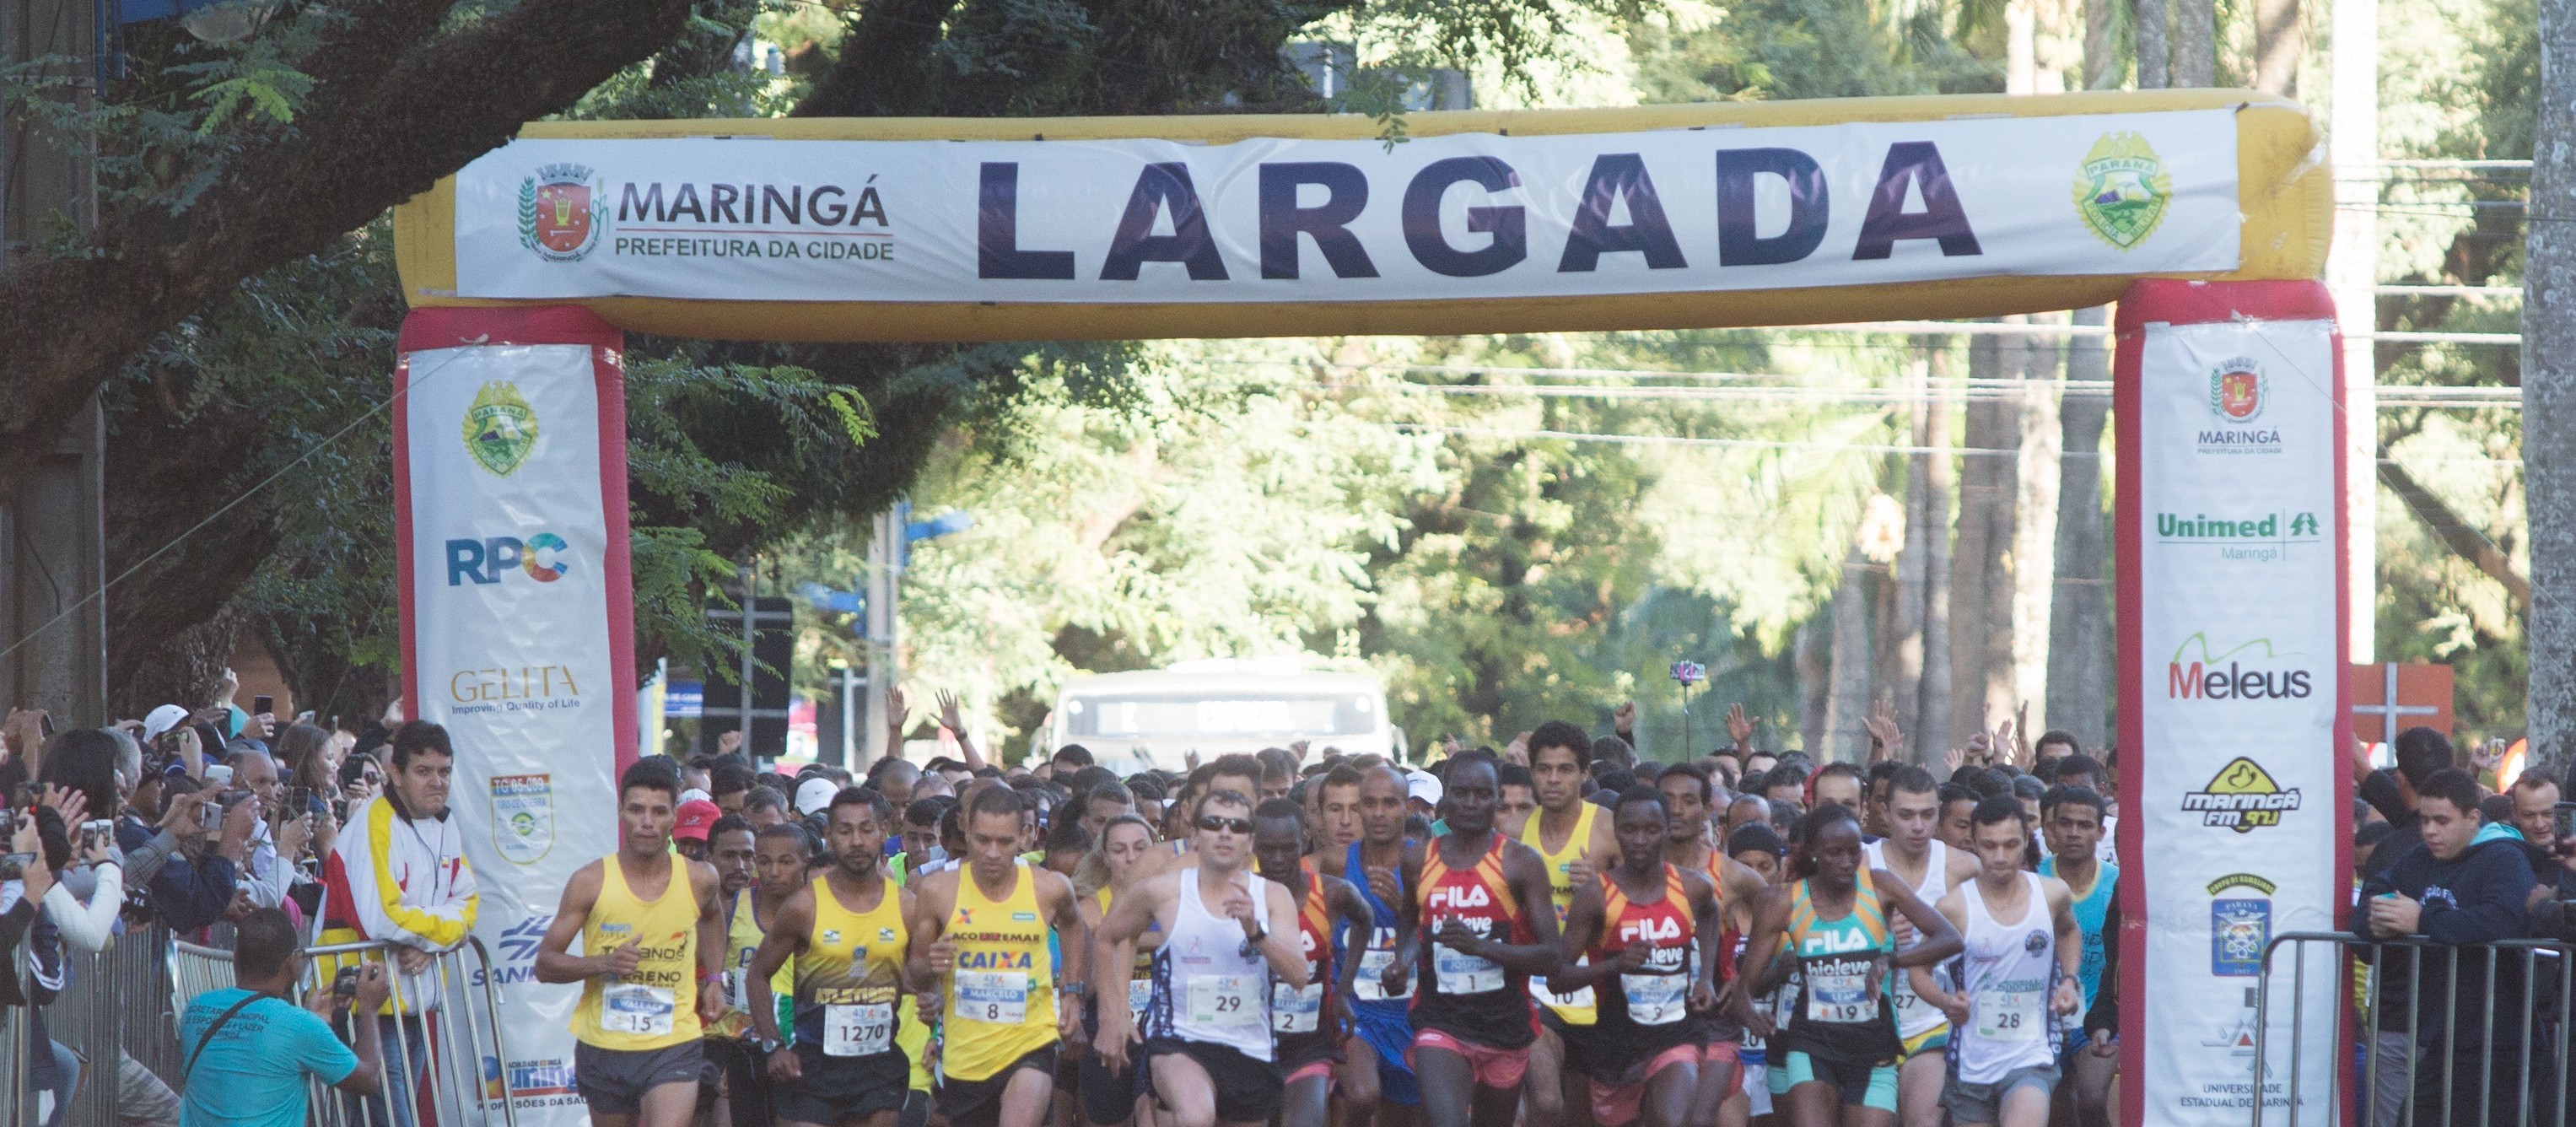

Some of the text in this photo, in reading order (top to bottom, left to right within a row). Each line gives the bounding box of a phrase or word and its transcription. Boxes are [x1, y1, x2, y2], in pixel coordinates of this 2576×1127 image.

[617, 174, 890, 227] MARINGÁ
[978, 141, 1984, 281] LARGADA
[615, 237, 894, 261] PREFEITURA DA CIDADE
[2198, 425, 2282, 445] MARINGÁ
[2255, 446, 2282, 455] CIDADE
[2157, 512, 2277, 539] Unimed
[445, 532, 569, 587] RPC
[2221, 545, 2278, 563] Maringá
[450, 665, 579, 703] GELITA
[2169, 661, 2313, 700] Meleus
[452, 698, 580, 715] Improving Quality of Life
[2205, 810, 2279, 826] FM 97.1
[1430, 884, 1490, 909] FILA
[1620, 916, 1681, 942] FILA
[1806, 926, 1868, 954] FILA
[958, 950, 1032, 969] CAIXA
[1468, 974, 1475, 989] 1
[969, 989, 1018, 1000] MARCELO
[1215, 995, 1241, 1012] 29
[1894, 995, 1916, 1009] 27
[987, 1003, 999, 1020] 8
[1836, 1005, 1858, 1020] 19
[1997, 1012, 2020, 1028] 28
[631, 1014, 652, 1032] 15
[1282, 1013, 1294, 1029] 2
[841, 1023, 885, 1042] 1270
[2203, 1083, 2282, 1094] UNIVERSIADE
[549, 1097, 564, 1106] DA
[2180, 1097, 2235, 1108] ESTADUAL
[2238, 1097, 2254, 1108] DE
